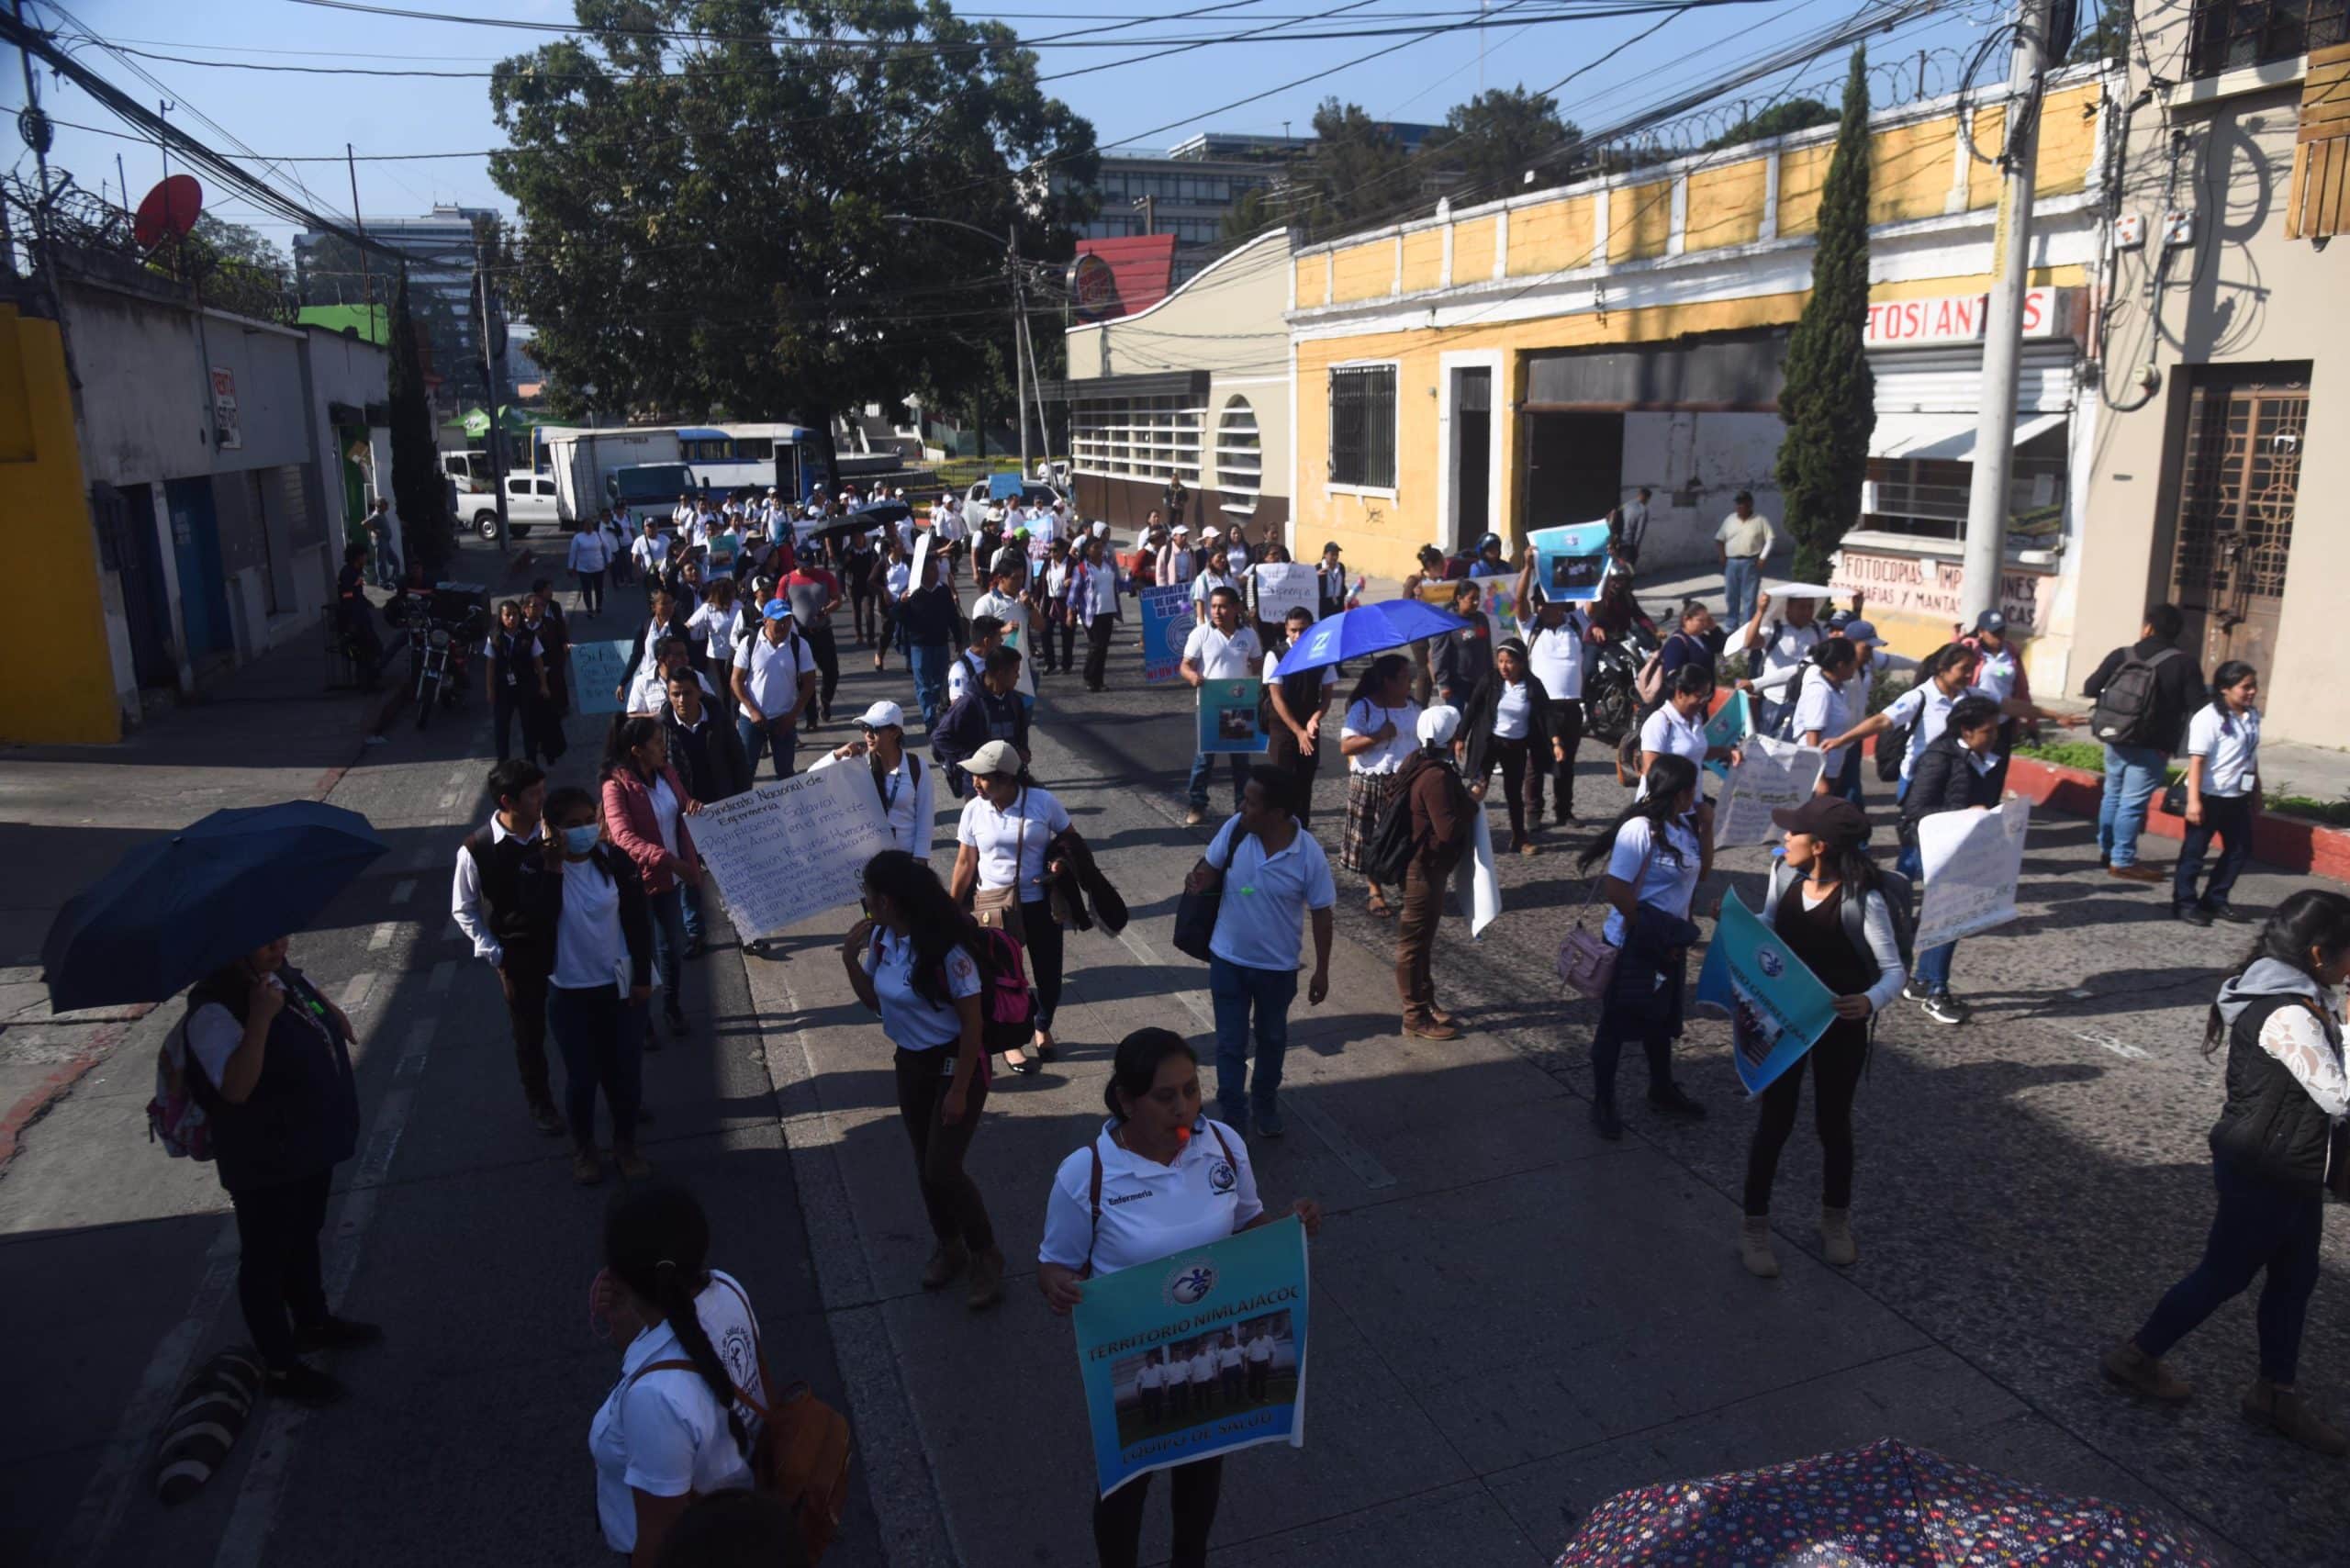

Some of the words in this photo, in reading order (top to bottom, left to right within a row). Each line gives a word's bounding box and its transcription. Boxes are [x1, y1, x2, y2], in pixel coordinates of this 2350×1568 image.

[1845, 556, 1922, 586] FOTOCOPIAS
[1902, 590, 1910, 606] Y
[699, 798, 754, 822] Sindicato
[756, 780, 804, 802] Nacional
[806, 775, 823, 788] de
[1088, 1320, 1192, 1361] TERRITORIO
